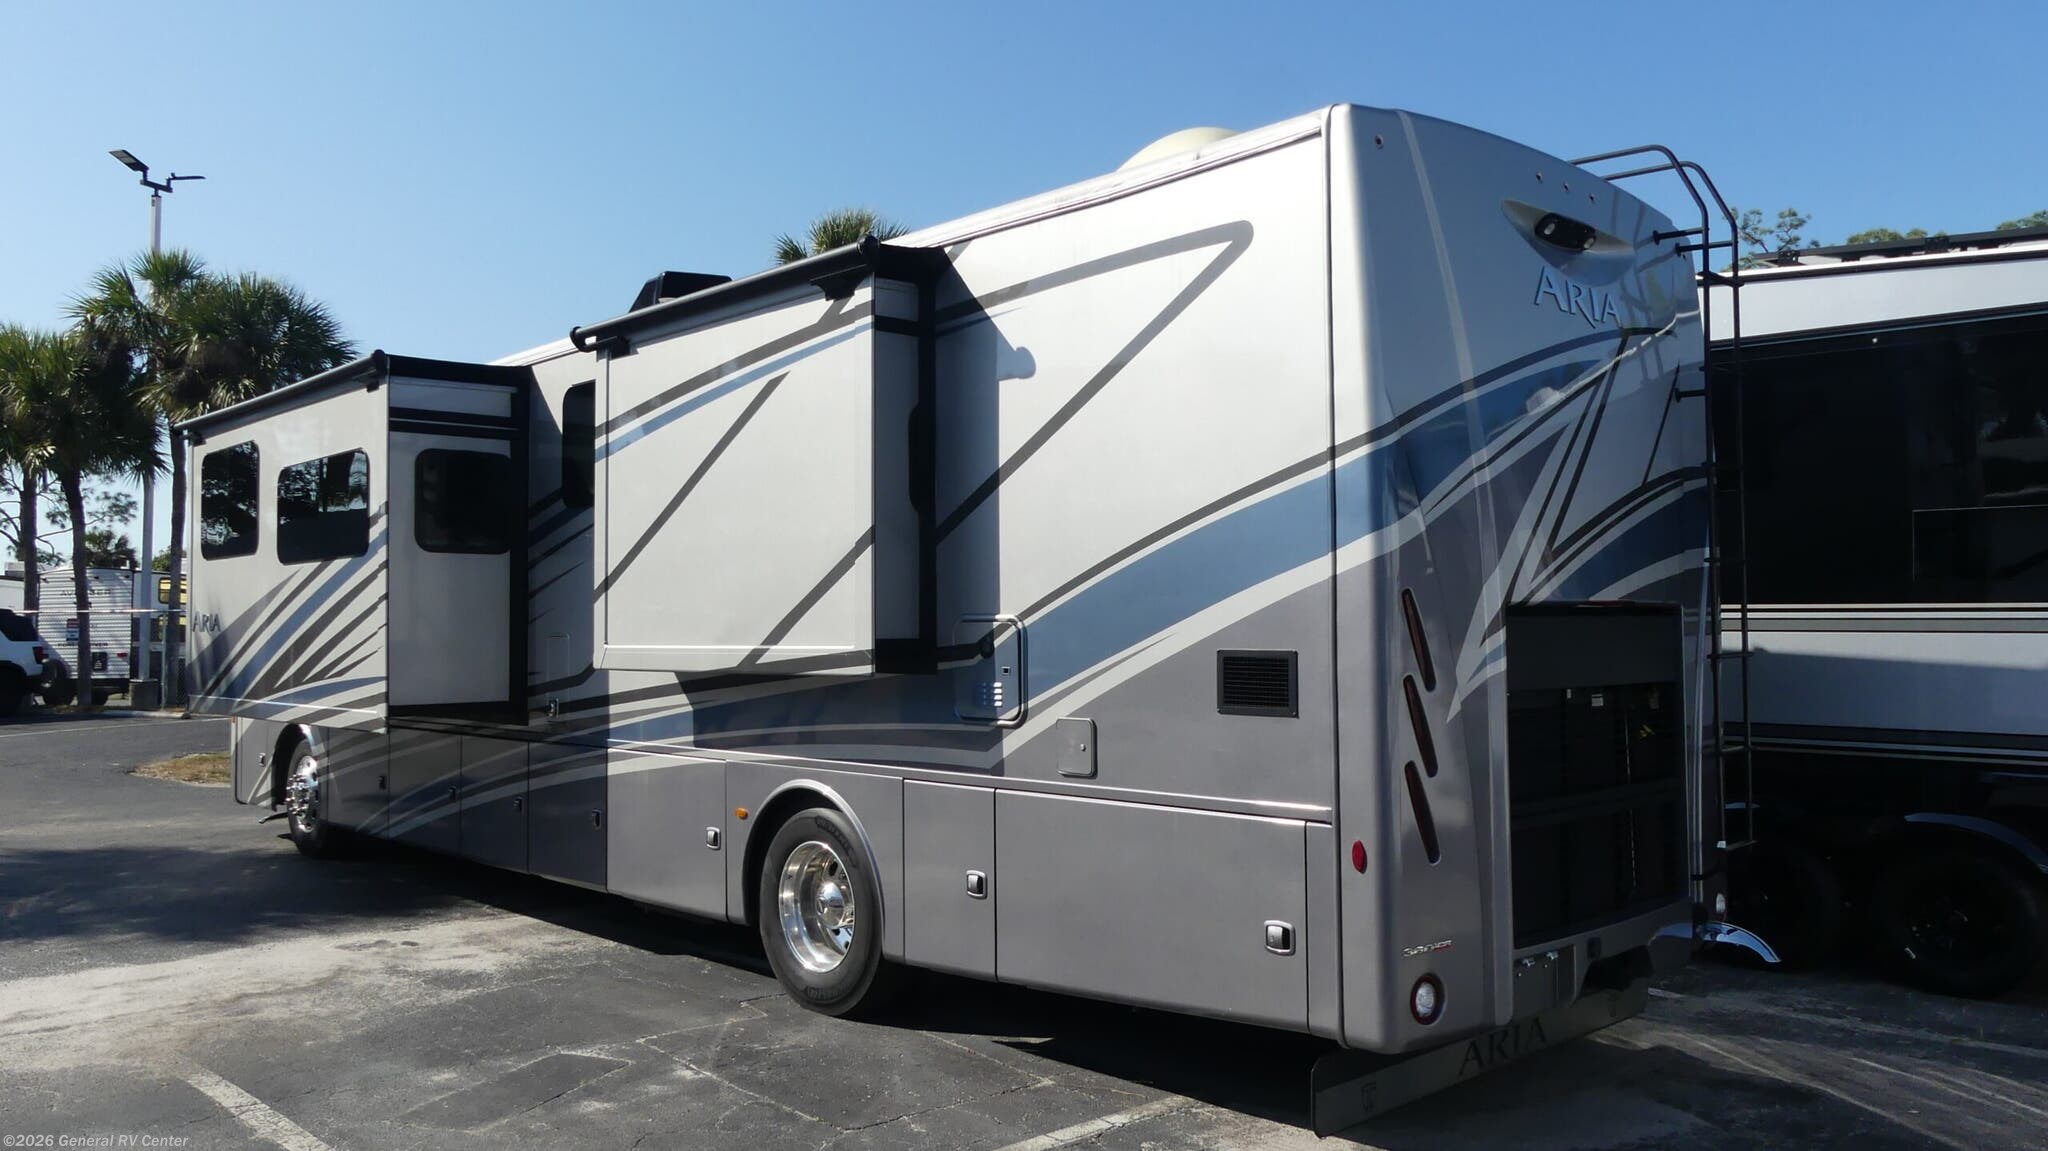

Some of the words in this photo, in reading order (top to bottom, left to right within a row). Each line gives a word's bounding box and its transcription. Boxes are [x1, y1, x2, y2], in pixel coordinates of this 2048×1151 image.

[1533, 265, 1622, 329] ARIA
[192, 611, 222, 635] ARIA
[1458, 1015, 1547, 1077] ARIA
